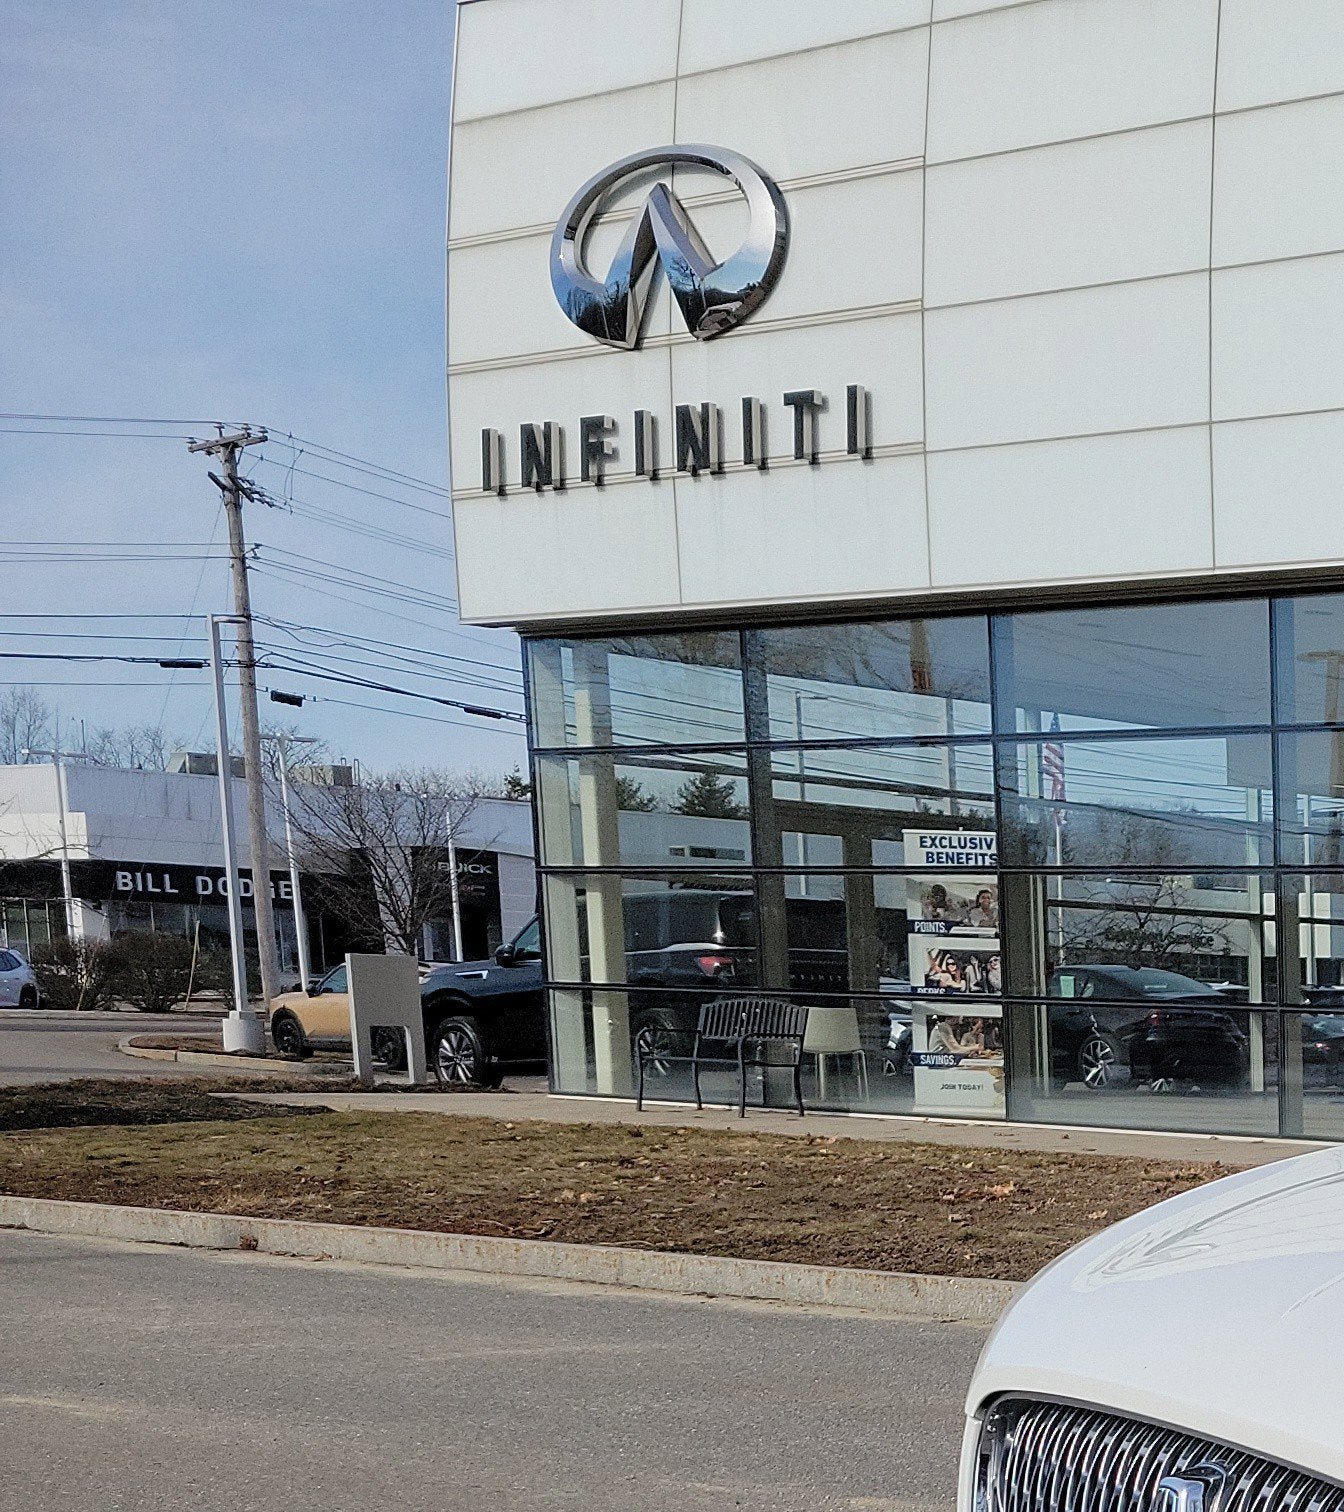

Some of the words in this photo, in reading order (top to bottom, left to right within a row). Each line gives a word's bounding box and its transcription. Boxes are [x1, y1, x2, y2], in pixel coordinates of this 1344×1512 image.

[482, 384, 867, 492] INFINITI
[919, 835, 994, 850] EXCLUSIV
[925, 851, 998, 866] BENEFITS
[115, 870, 179, 894] BILL
